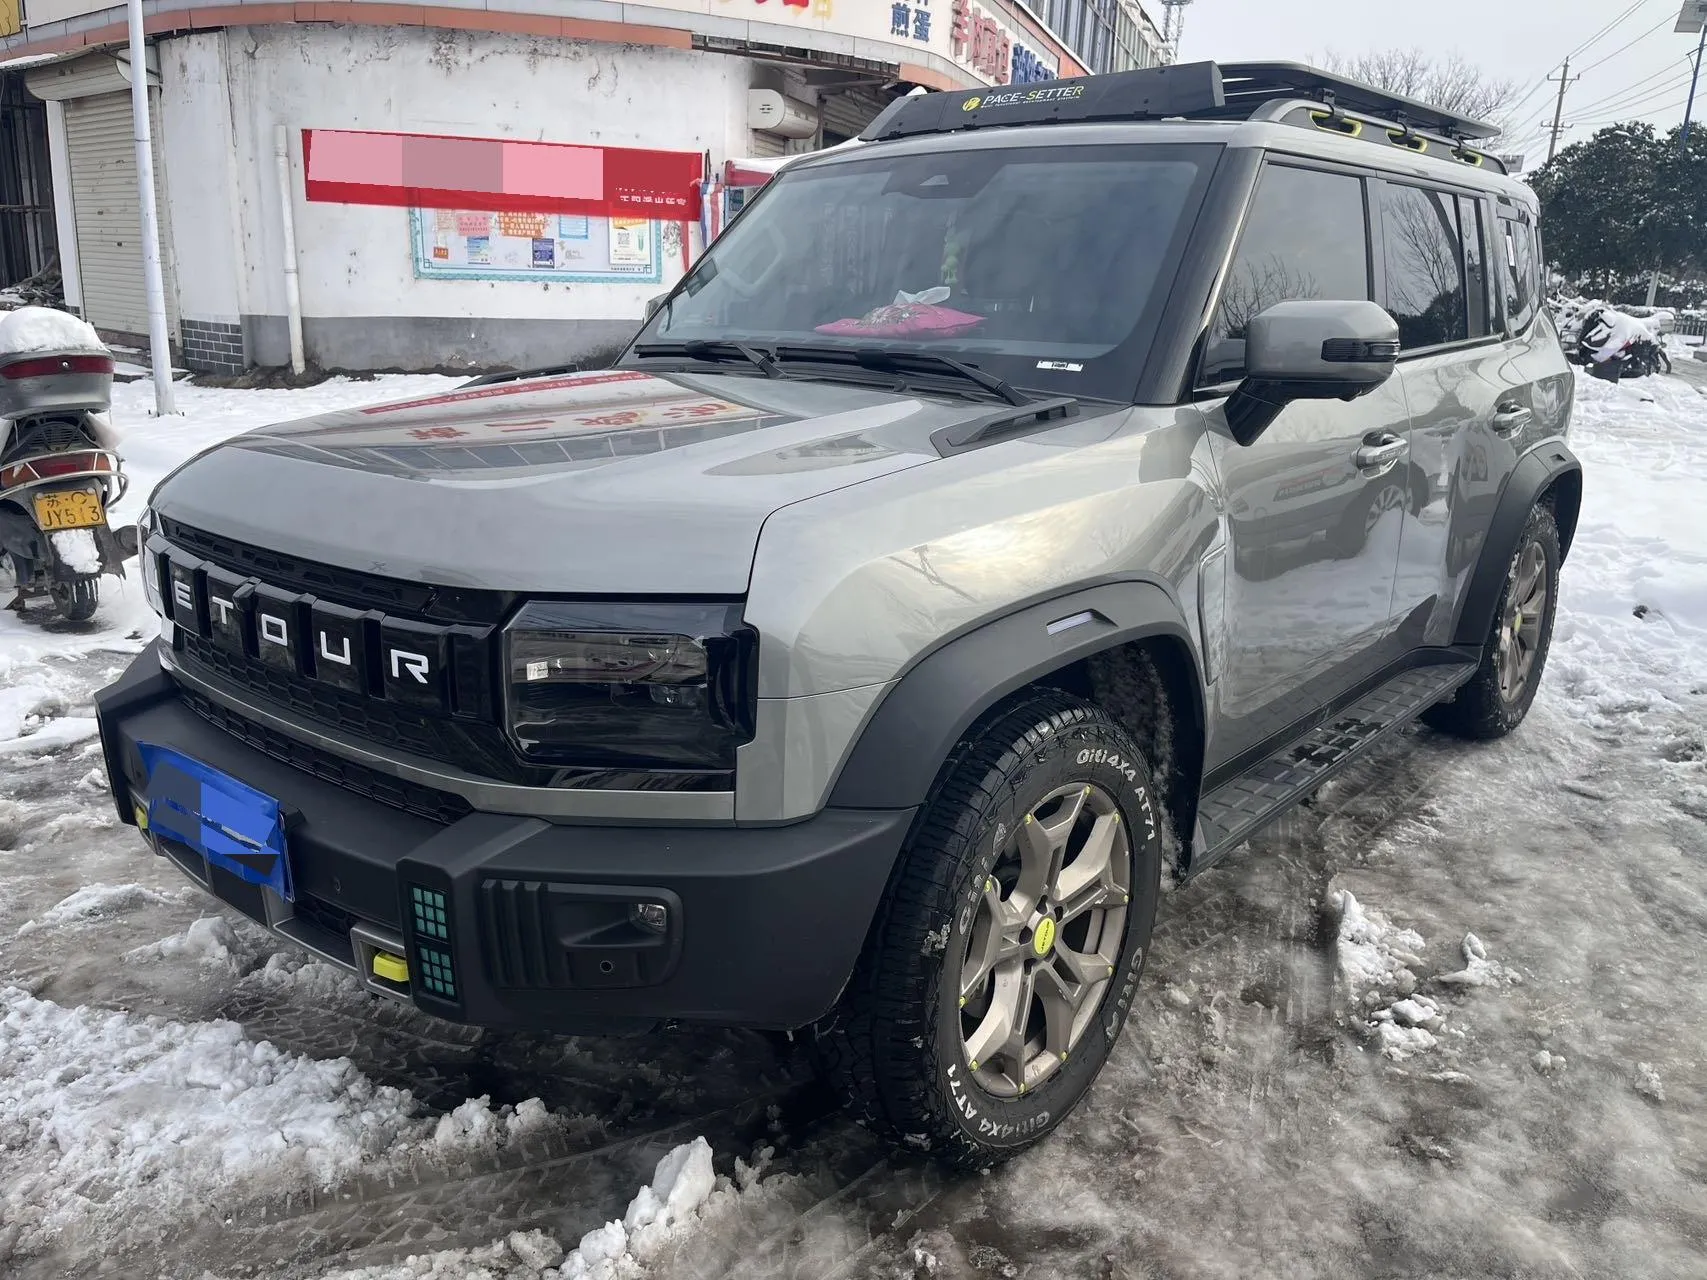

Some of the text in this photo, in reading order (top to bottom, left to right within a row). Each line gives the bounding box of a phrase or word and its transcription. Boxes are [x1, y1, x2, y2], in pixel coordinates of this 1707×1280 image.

[891, 2, 931, 42] 煎蛋
[984, 86, 1084, 105] PACE-SETTER
[1134, 786, 1155, 840] AT71
[947, 1063, 978, 1120] AT71
